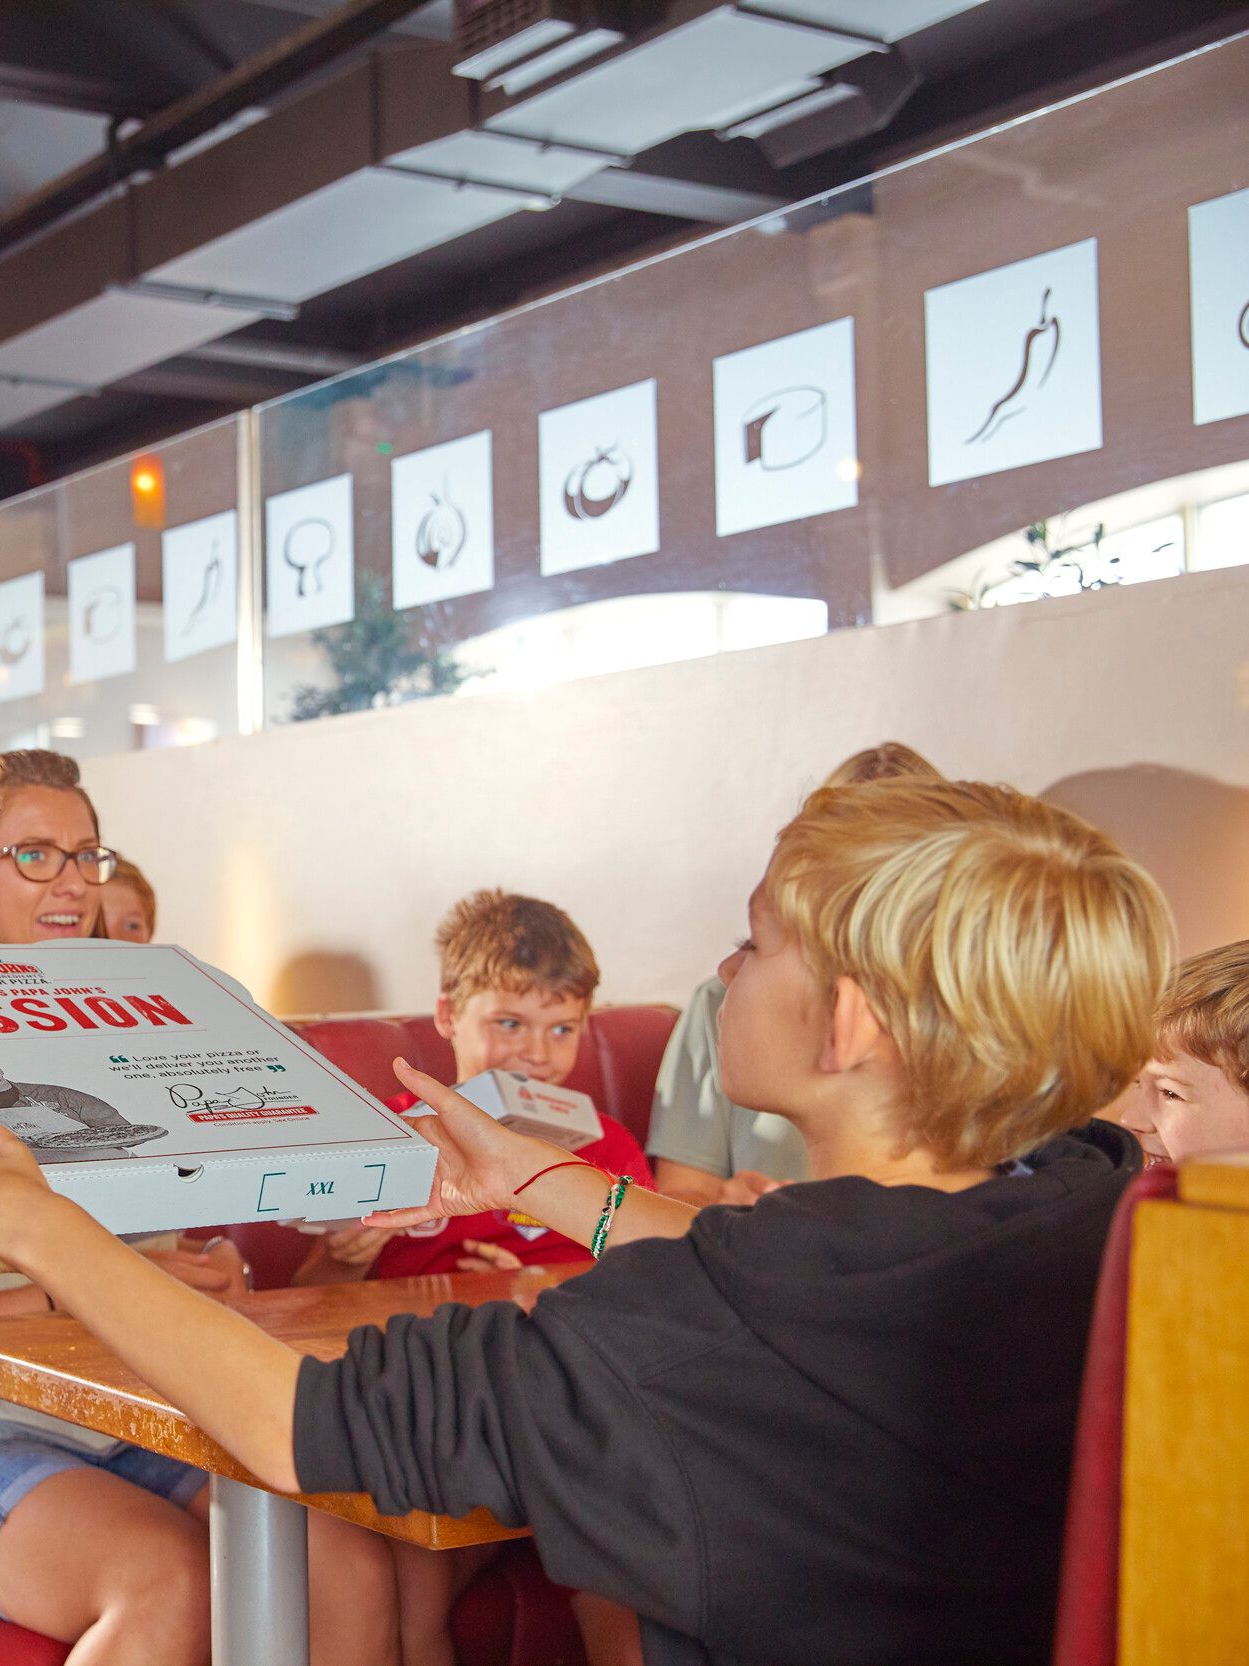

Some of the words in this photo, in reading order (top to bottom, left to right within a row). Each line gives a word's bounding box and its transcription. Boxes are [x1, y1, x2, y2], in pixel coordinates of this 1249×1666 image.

[9, 988, 50, 997] PAPA
[53, 986, 107, 995] JOHN'S
[206, 1051, 243, 1059] pizza
[109, 1064, 142, 1072] we'll
[145, 1062, 192, 1070] deliver
[227, 1056, 279, 1065] another
[158, 1067, 230, 1078] absolutely
[225, 1110, 261, 1119] QUALITY
[260, 1107, 308, 1118] GUARANTEE
[306, 1181, 335, 1196] XXL
